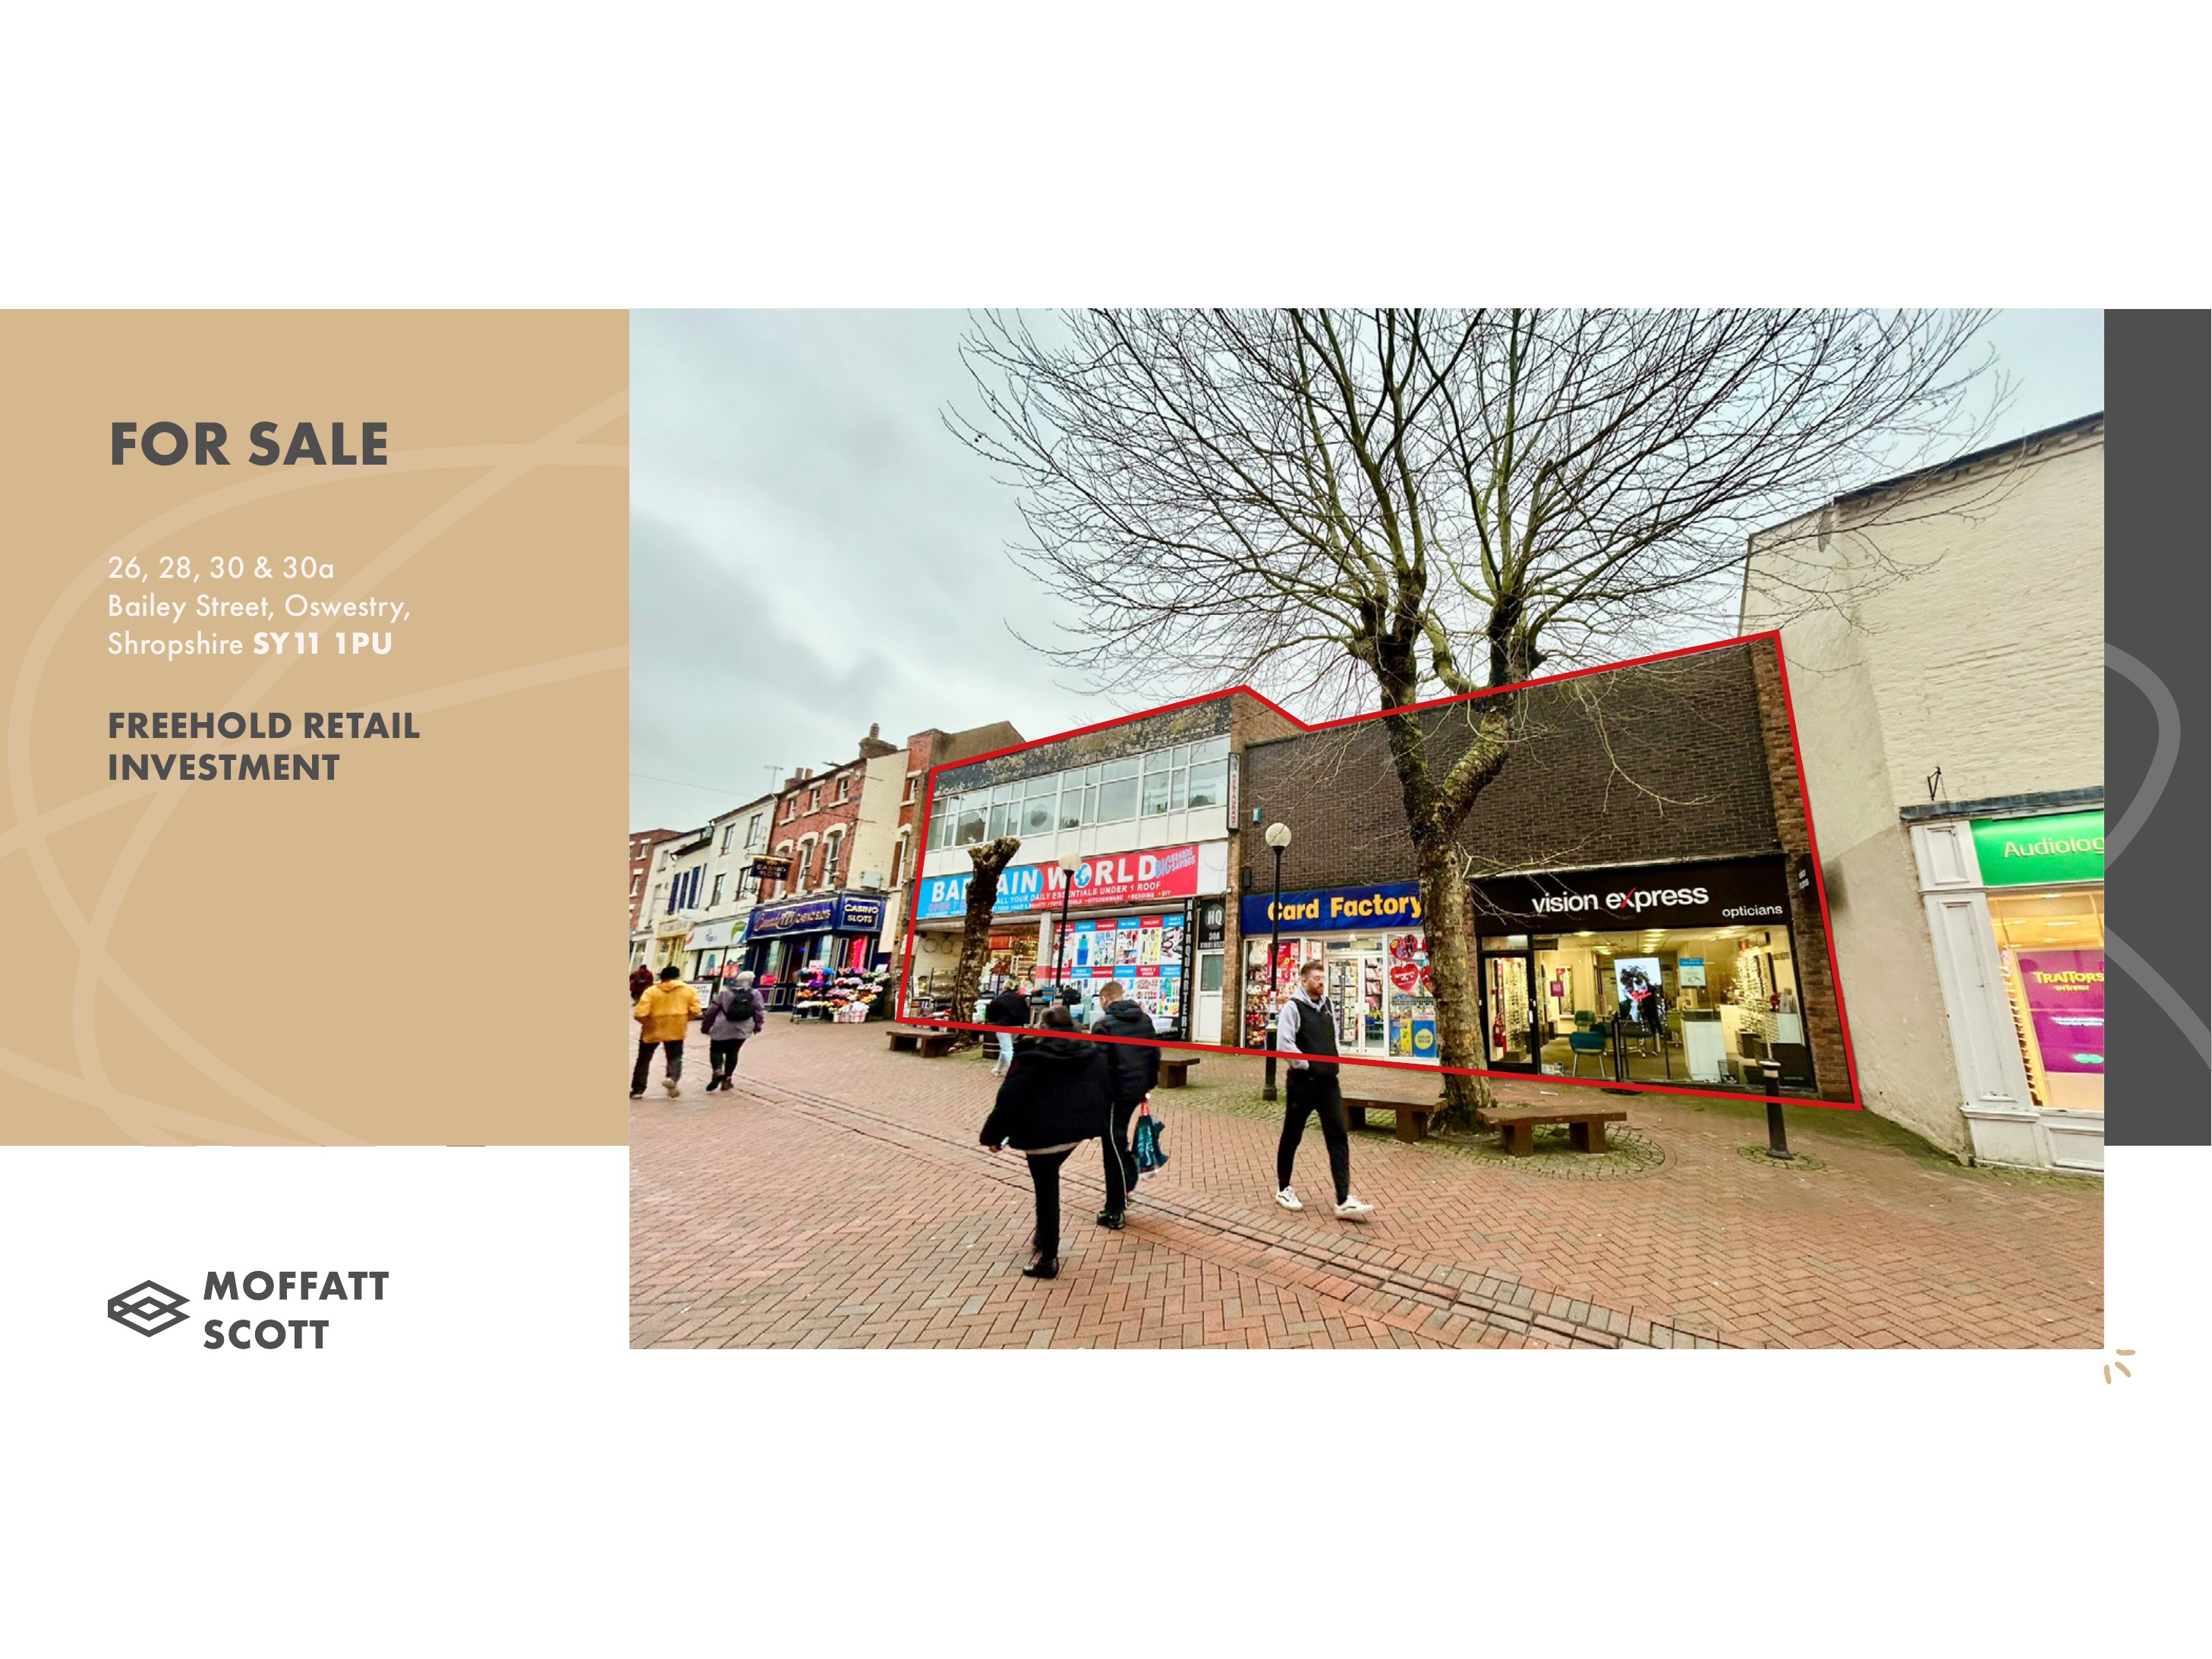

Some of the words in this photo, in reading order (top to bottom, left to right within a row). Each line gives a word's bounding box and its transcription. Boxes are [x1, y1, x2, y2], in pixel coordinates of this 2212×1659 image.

[2004, 836, 2104, 858] Audiolog
[1155, 856, 1171, 878] BIG
[931, 869, 1038, 902] BAAIN
[1031, 892, 1051, 901] DAILY
[1100, 885, 1128, 894] UNDER
[1137, 881, 1161, 891] ROOF
[844, 904, 879, 914] CASINO
[1268, 899, 1319, 921] Card
[1331, 894, 1422, 919] Factory
[1532, 891, 1599, 913] vision
[1605, 887, 1709, 913] express
[847, 914, 873, 923] SLOTS
[1208, 910, 1222, 926] HQ
[1722, 904, 1783, 918] opticians
